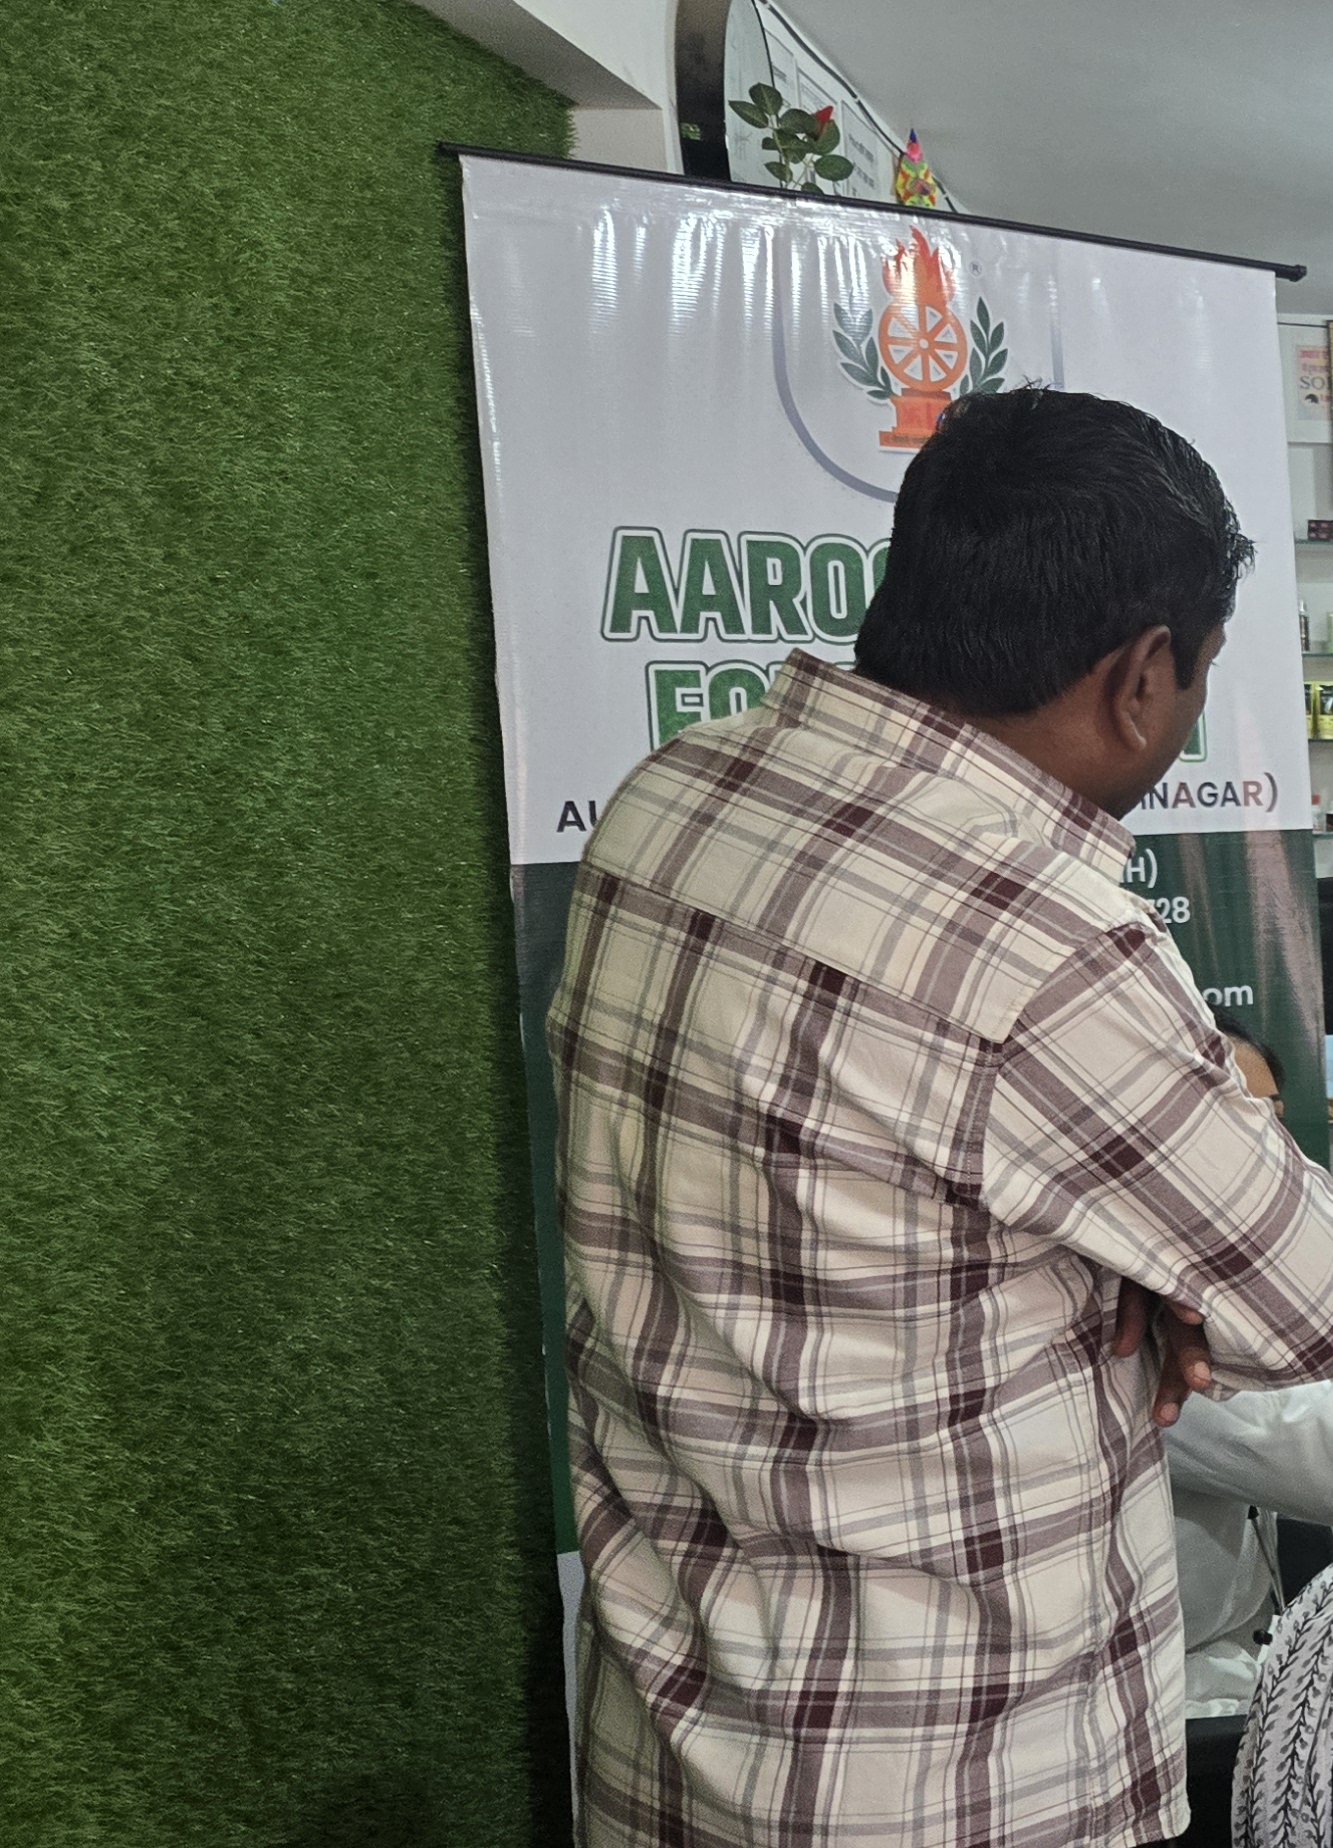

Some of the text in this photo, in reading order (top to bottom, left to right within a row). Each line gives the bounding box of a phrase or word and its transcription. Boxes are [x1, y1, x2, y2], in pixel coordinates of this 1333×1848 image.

[1300, 376, 1331, 390] SO
[1123, 848, 1159, 889] H)
[1151, 896, 1192, 925] 28
[1200, 984, 1255, 1008] om
